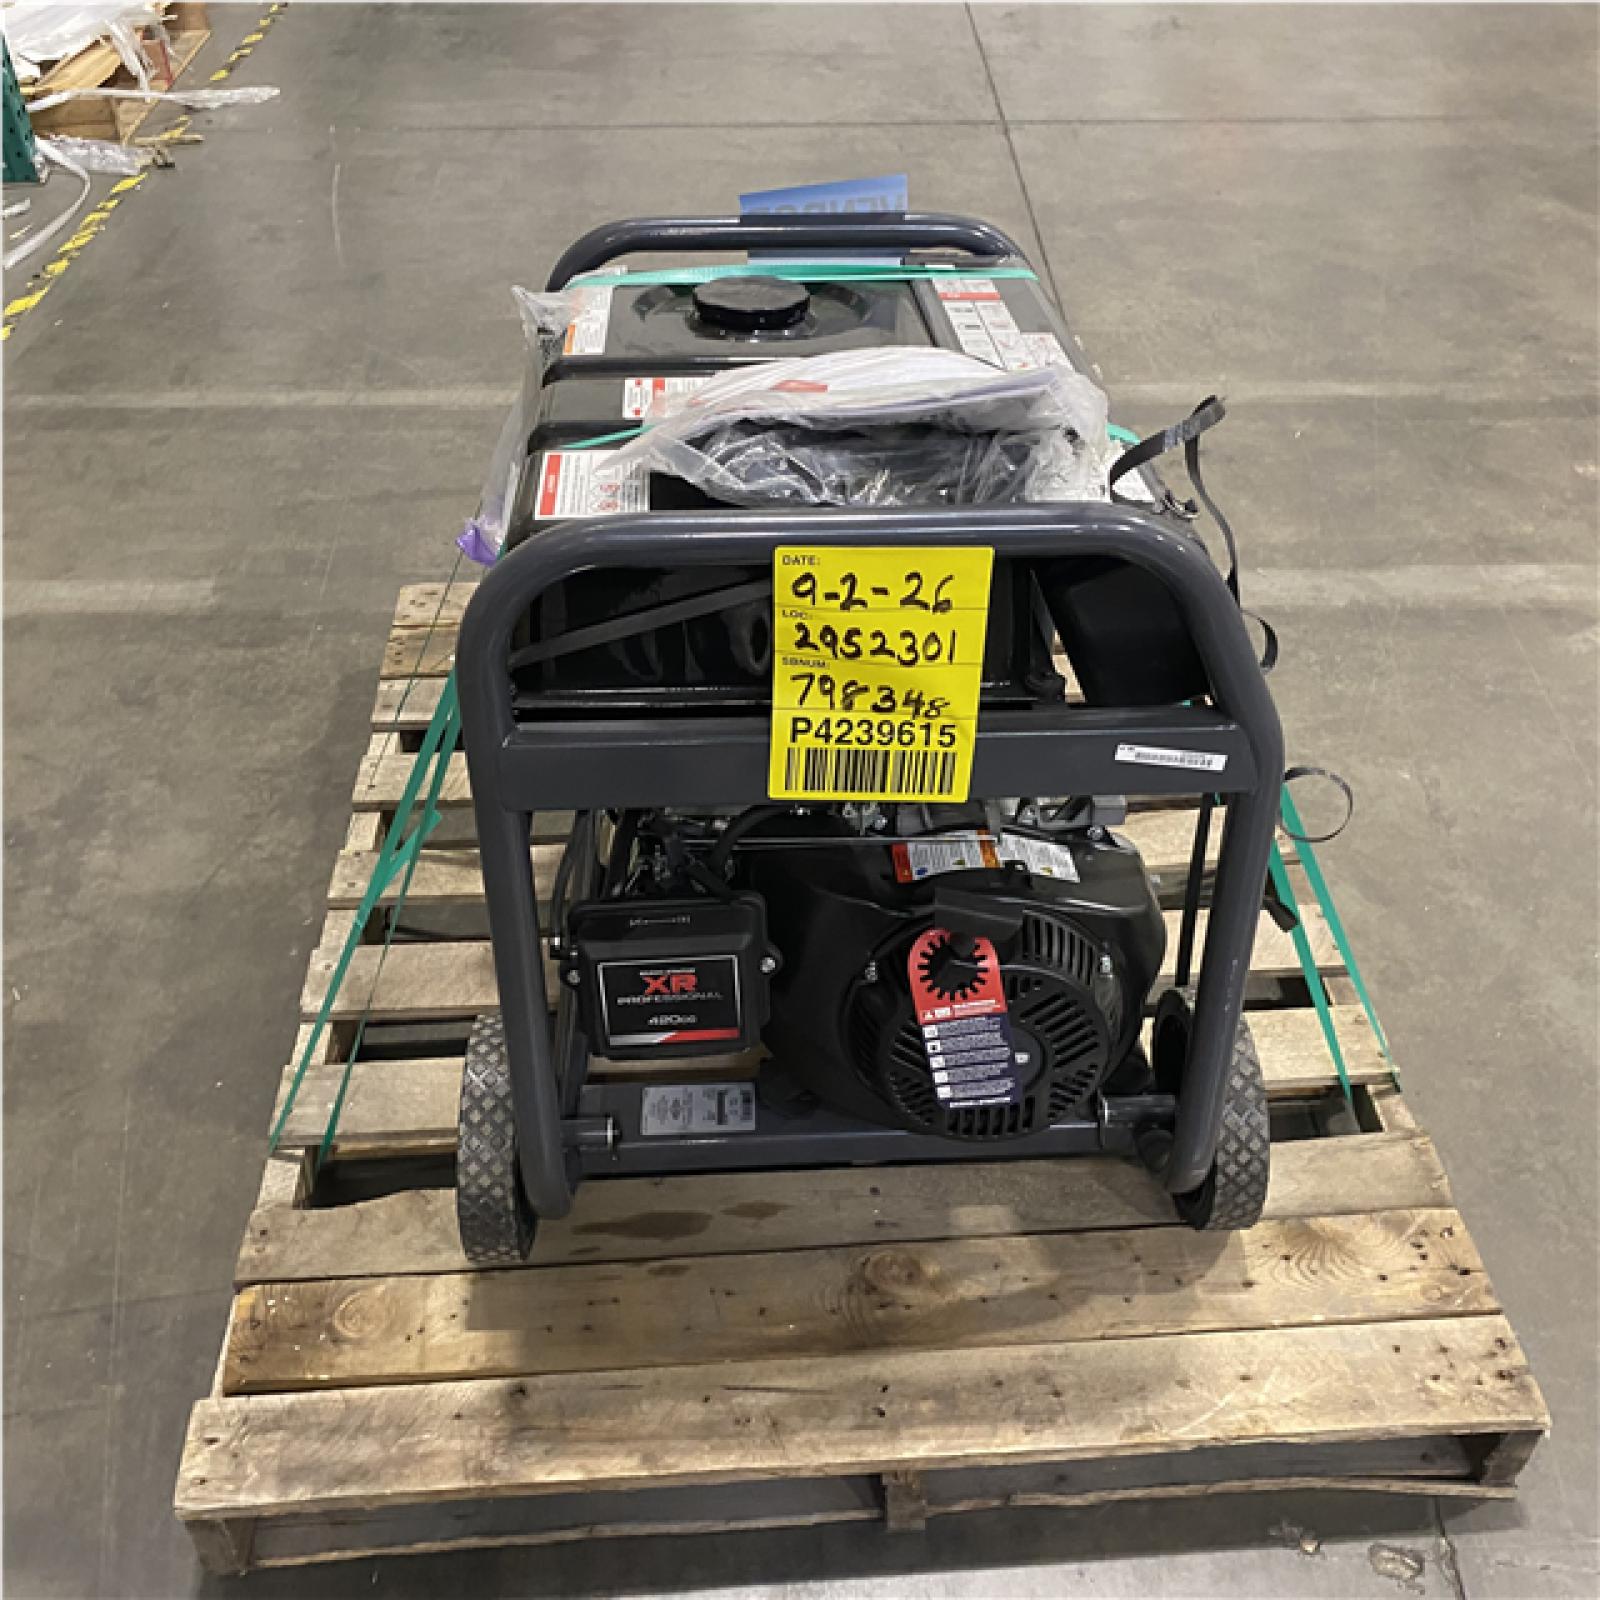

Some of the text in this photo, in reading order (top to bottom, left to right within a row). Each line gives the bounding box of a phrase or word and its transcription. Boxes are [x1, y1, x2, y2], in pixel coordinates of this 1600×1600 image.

[782, 554, 820, 566] DATE:
[794, 621, 956, 667] 2952301
[791, 716, 956, 748] P4239615
[642, 973, 697, 996] XR
